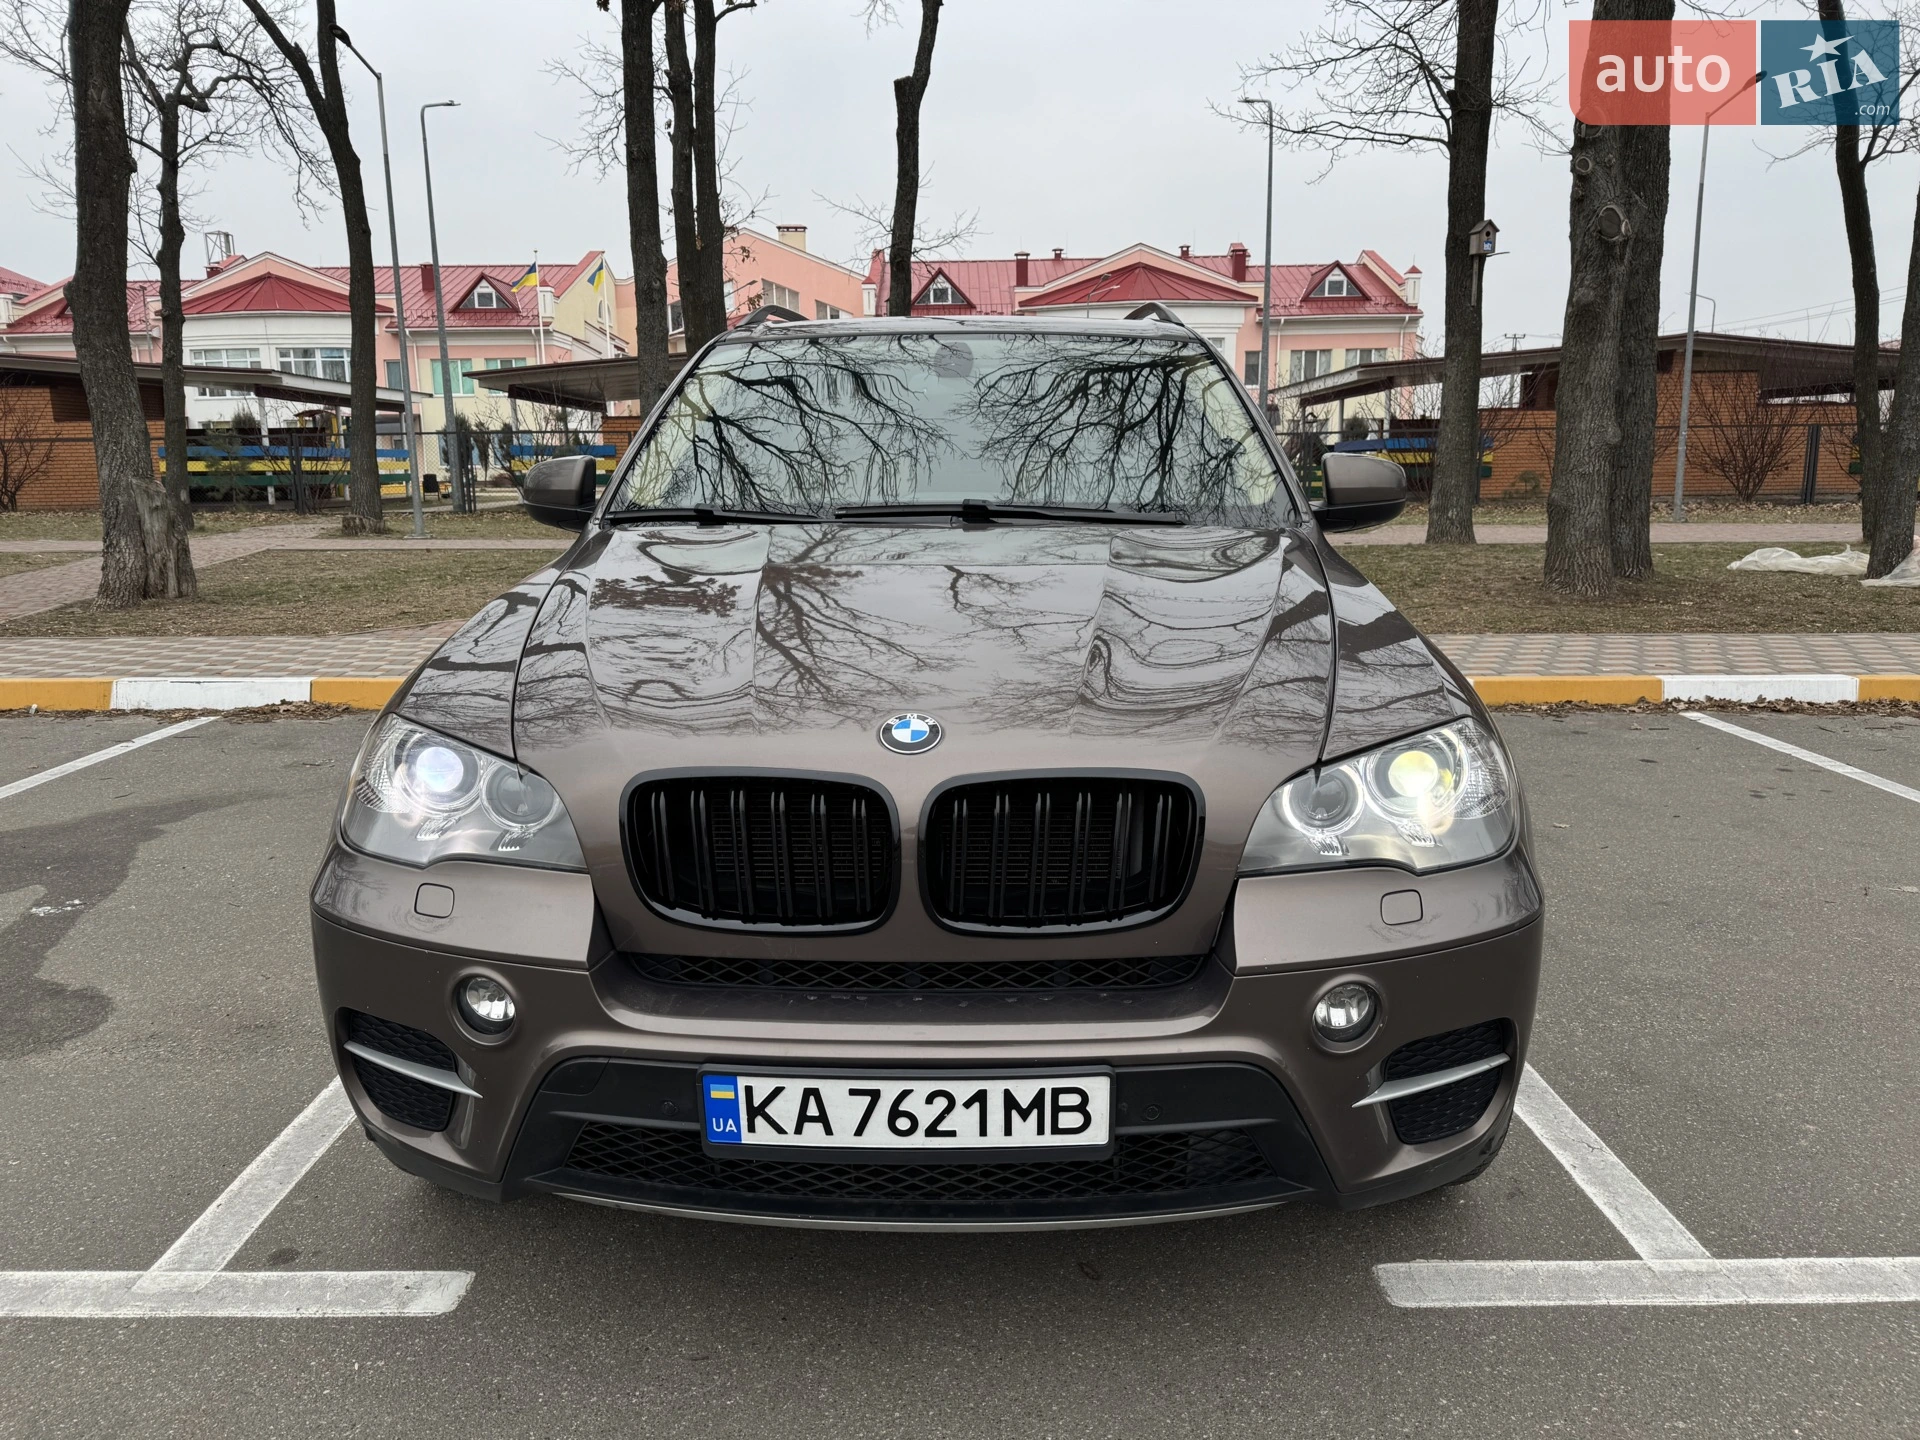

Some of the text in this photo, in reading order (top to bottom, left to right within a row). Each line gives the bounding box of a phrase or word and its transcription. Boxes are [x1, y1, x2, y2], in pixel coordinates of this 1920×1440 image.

[712, 1117, 737, 1133] UA
[743, 1085, 1092, 1137] KA 7621 MB
